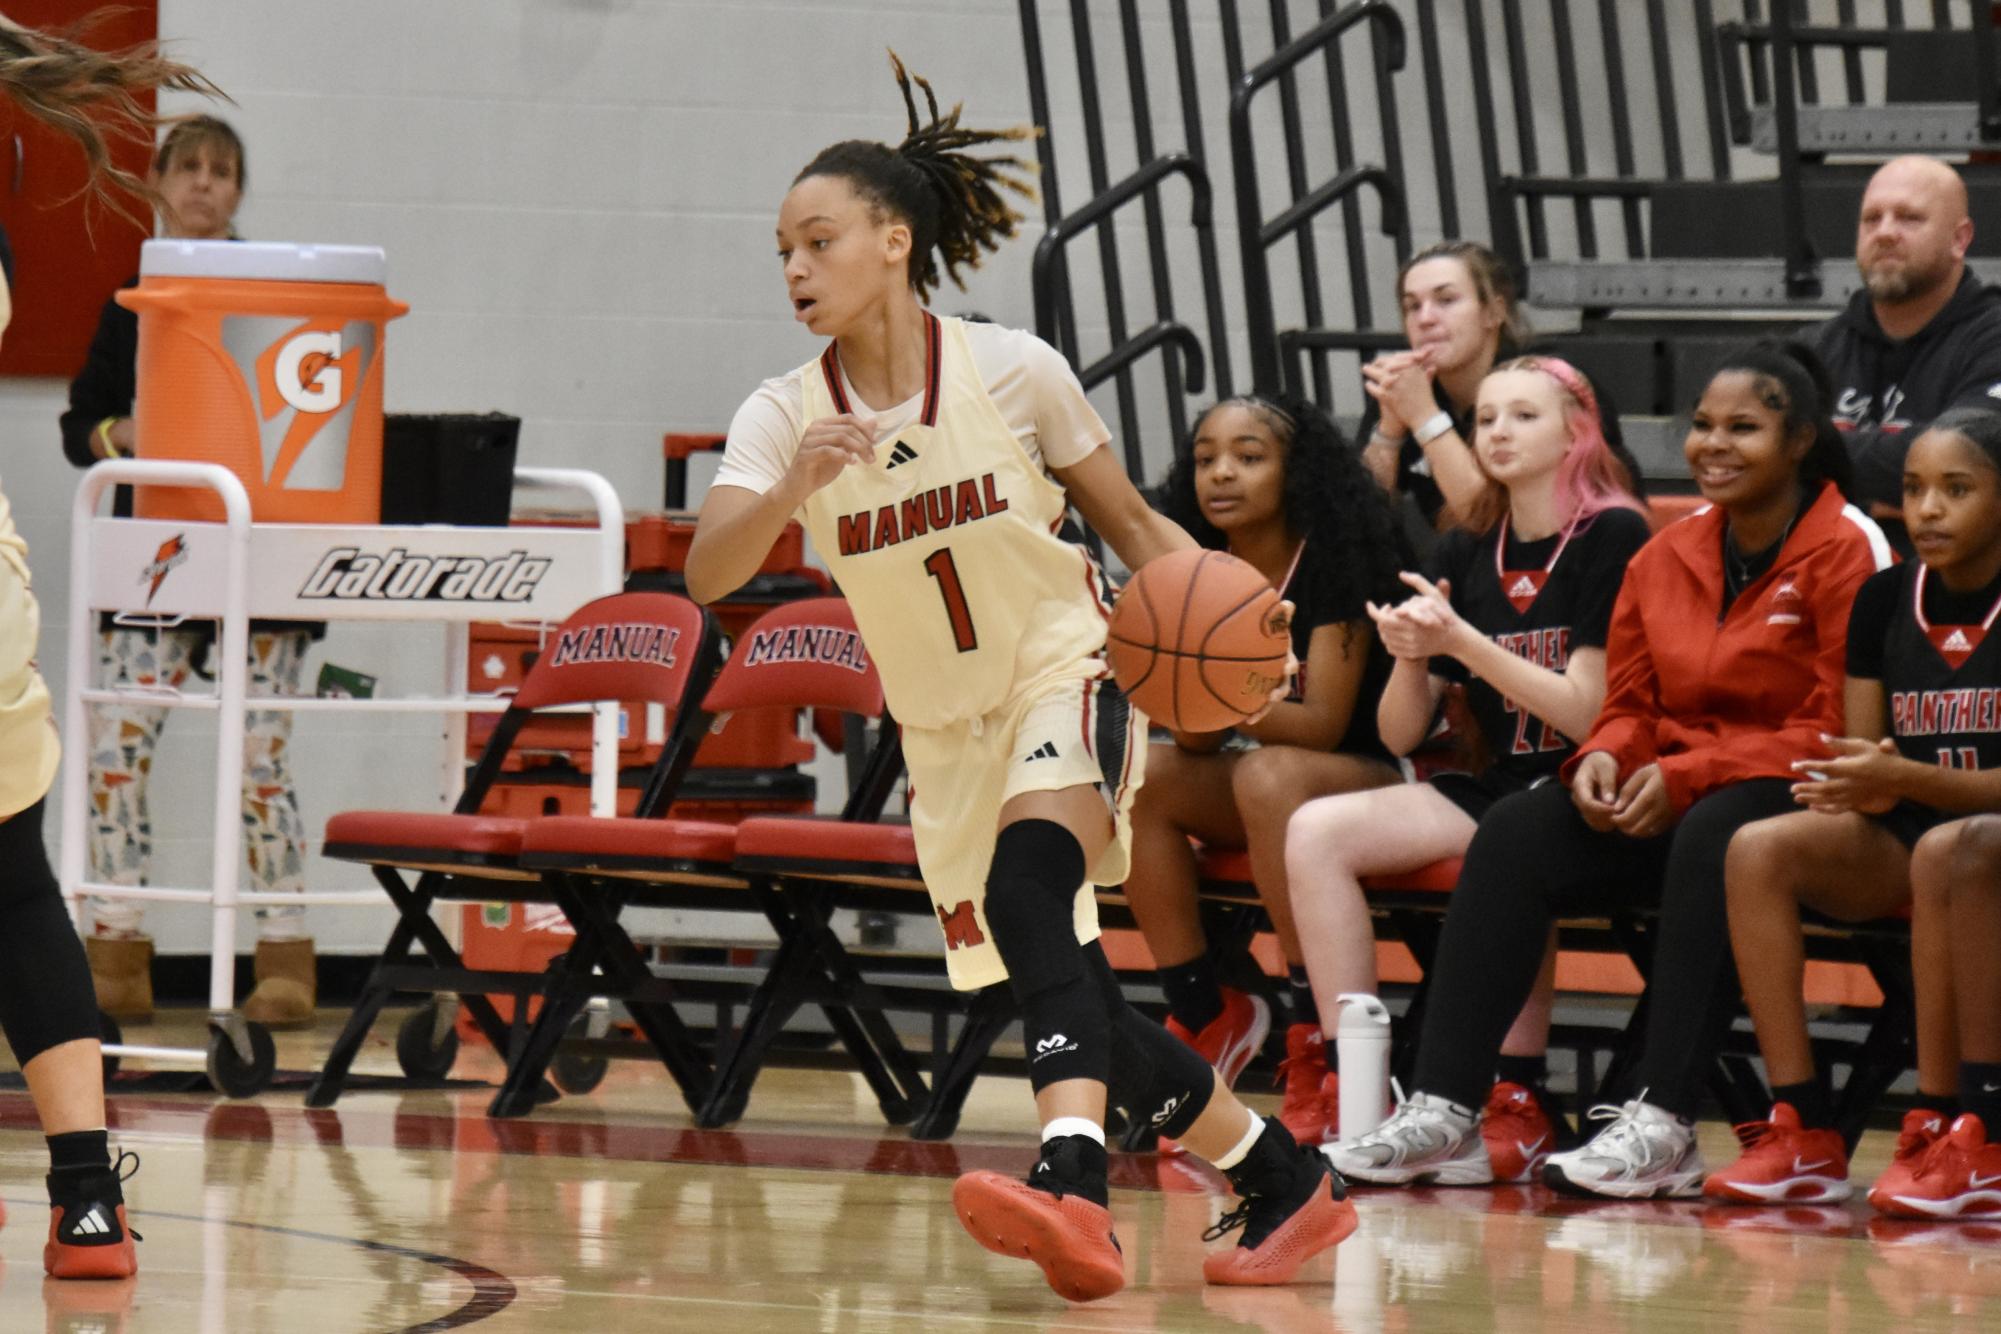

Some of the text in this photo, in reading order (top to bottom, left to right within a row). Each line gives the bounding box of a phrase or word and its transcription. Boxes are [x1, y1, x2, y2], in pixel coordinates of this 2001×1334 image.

[275, 331, 342, 413] G
[837, 472, 1008, 556] MANUAL
[297, 547, 553, 602] Gatorade
[924, 547, 978, 653] 1
[551, 623, 682, 669] MANUAL
[743, 625, 868, 674] MANUAL
[937, 899, 985, 951] M
